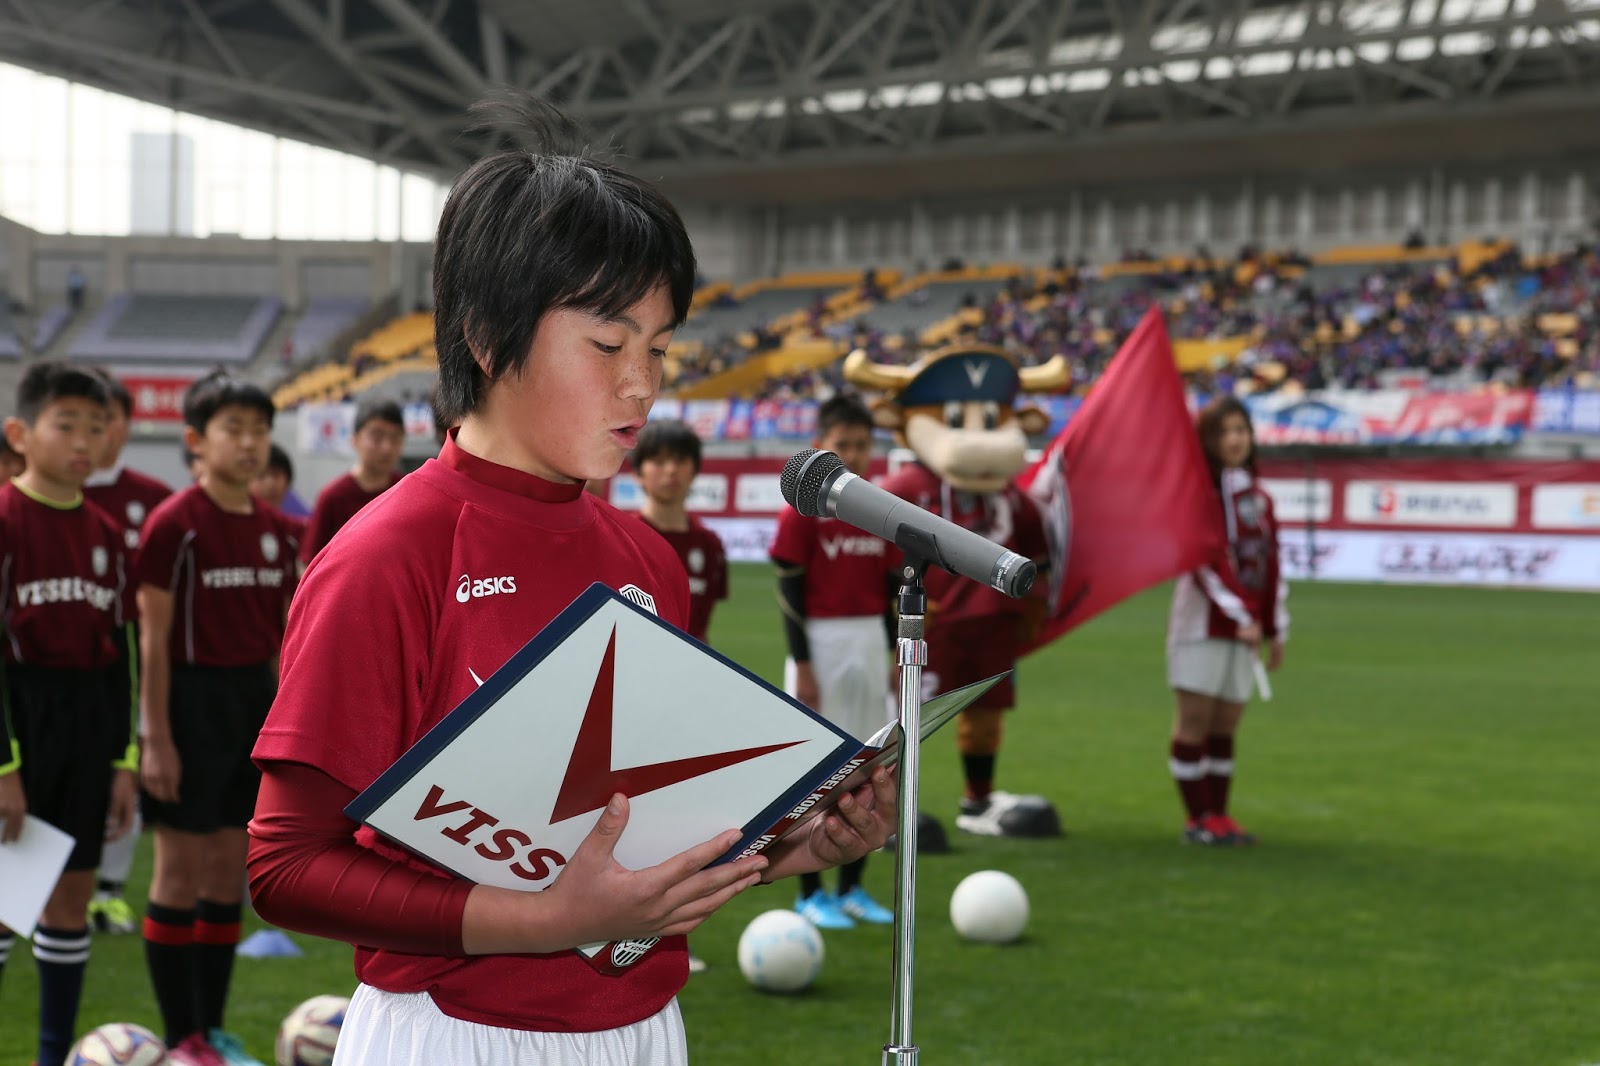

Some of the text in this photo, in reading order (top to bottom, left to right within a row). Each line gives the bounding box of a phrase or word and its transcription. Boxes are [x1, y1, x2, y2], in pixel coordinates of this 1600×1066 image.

[472, 576, 517, 597] asics
[785, 758, 866, 820] VISSEL KOBE
[414, 784, 567, 890] VISS
